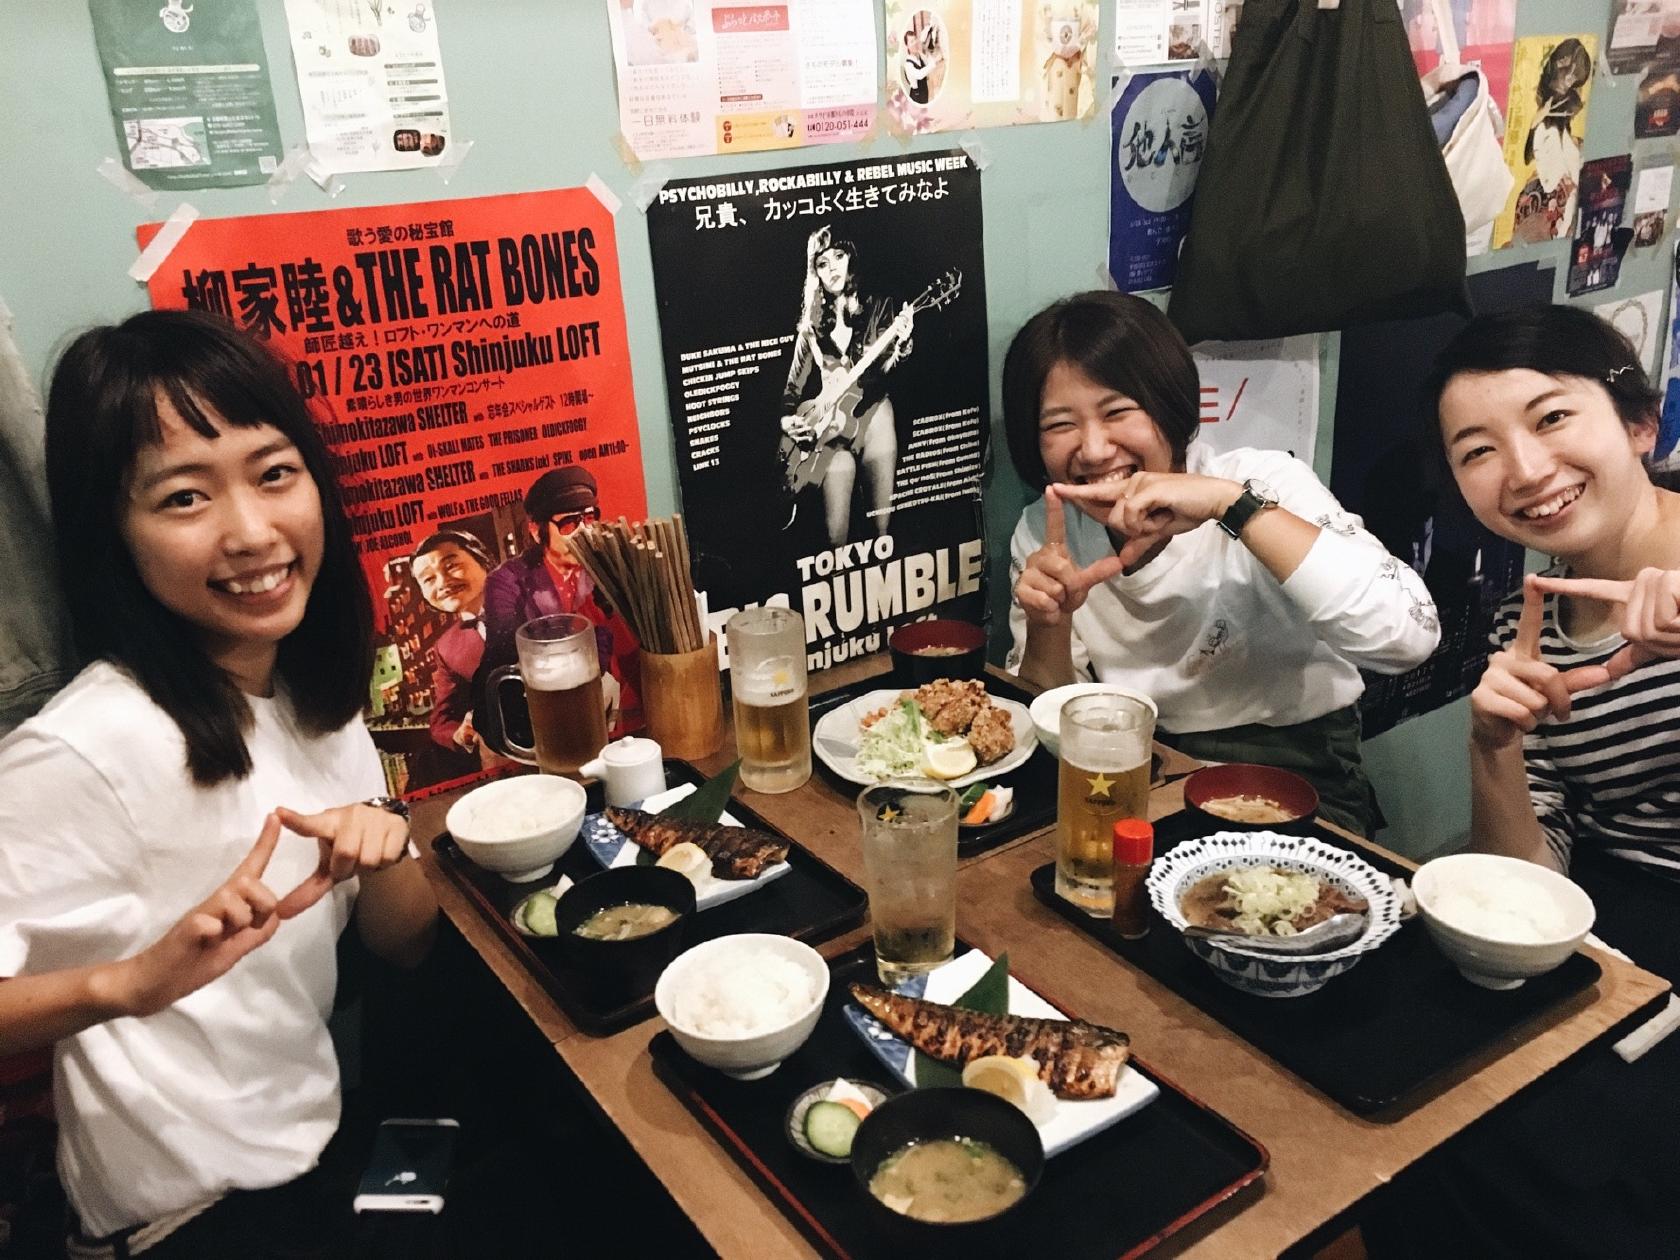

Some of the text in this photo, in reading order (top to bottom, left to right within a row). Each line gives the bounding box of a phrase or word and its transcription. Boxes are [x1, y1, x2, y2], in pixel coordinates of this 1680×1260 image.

[844, 169, 855, 184] &
[856, 164, 895, 182] REBEL
[897, 159, 934, 177] MUSIC
[934, 155, 968, 172] WEEK
[763, 177, 950, 221] カッコよく生きてみなよ
[347, 220, 455, 247] 歌う愛の秘宝館
[429, 240, 493, 315] RAT
[498, 227, 600, 306] BONES
[349, 352, 384, 393] 23
[451, 331, 554, 378] Shinjuku
[555, 321, 601, 361] LOFT
[417, 401, 468, 431] SHELTER
[378, 441, 409, 469] LOFT
[488, 432, 503, 447] THE
[503, 426, 538, 445] PRISONER
[425, 460, 476, 489] SHELTER
[492, 463, 506, 477] THE
[553, 450, 574, 466] SPIKE
[395, 500, 425, 528] LOFT
[437, 503, 459, 519] WOLF
[458, 503, 465, 514] &
[465, 499, 479, 513] THE
[796, 534, 894, 582] TOKYO
[801, 538, 983, 645] RUMBLE
